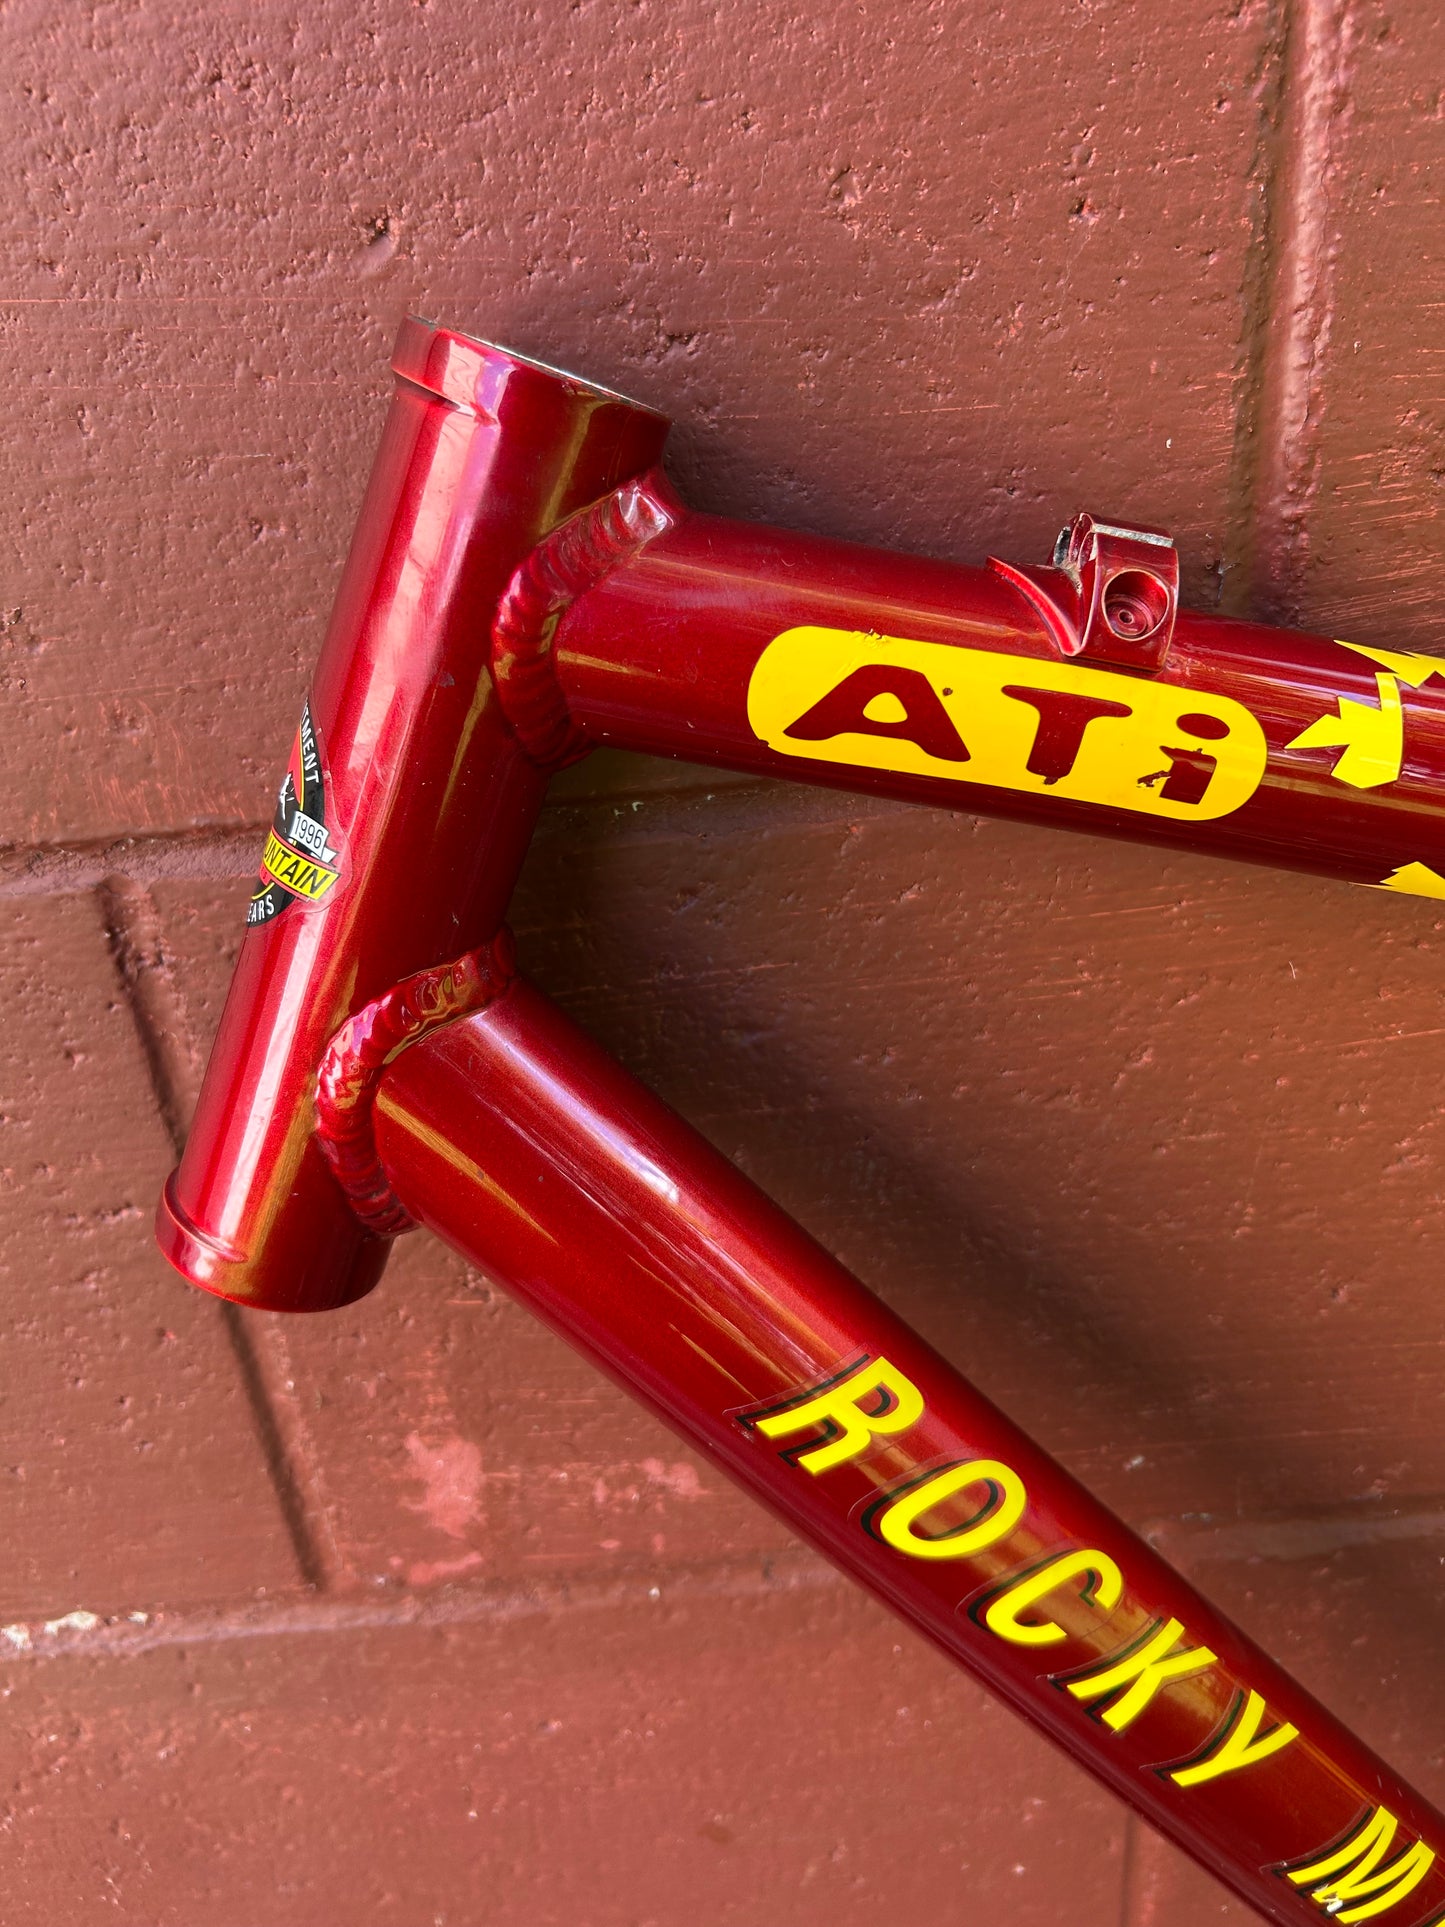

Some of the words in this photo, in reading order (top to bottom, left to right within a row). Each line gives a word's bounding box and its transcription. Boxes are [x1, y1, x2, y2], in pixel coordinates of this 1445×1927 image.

[301, 706, 319, 783] MENT
[294, 815, 324, 849] 1996
[753, 1355, 1300, 1788] ROCKY
[1286, 1804, 1445, 1927] M
